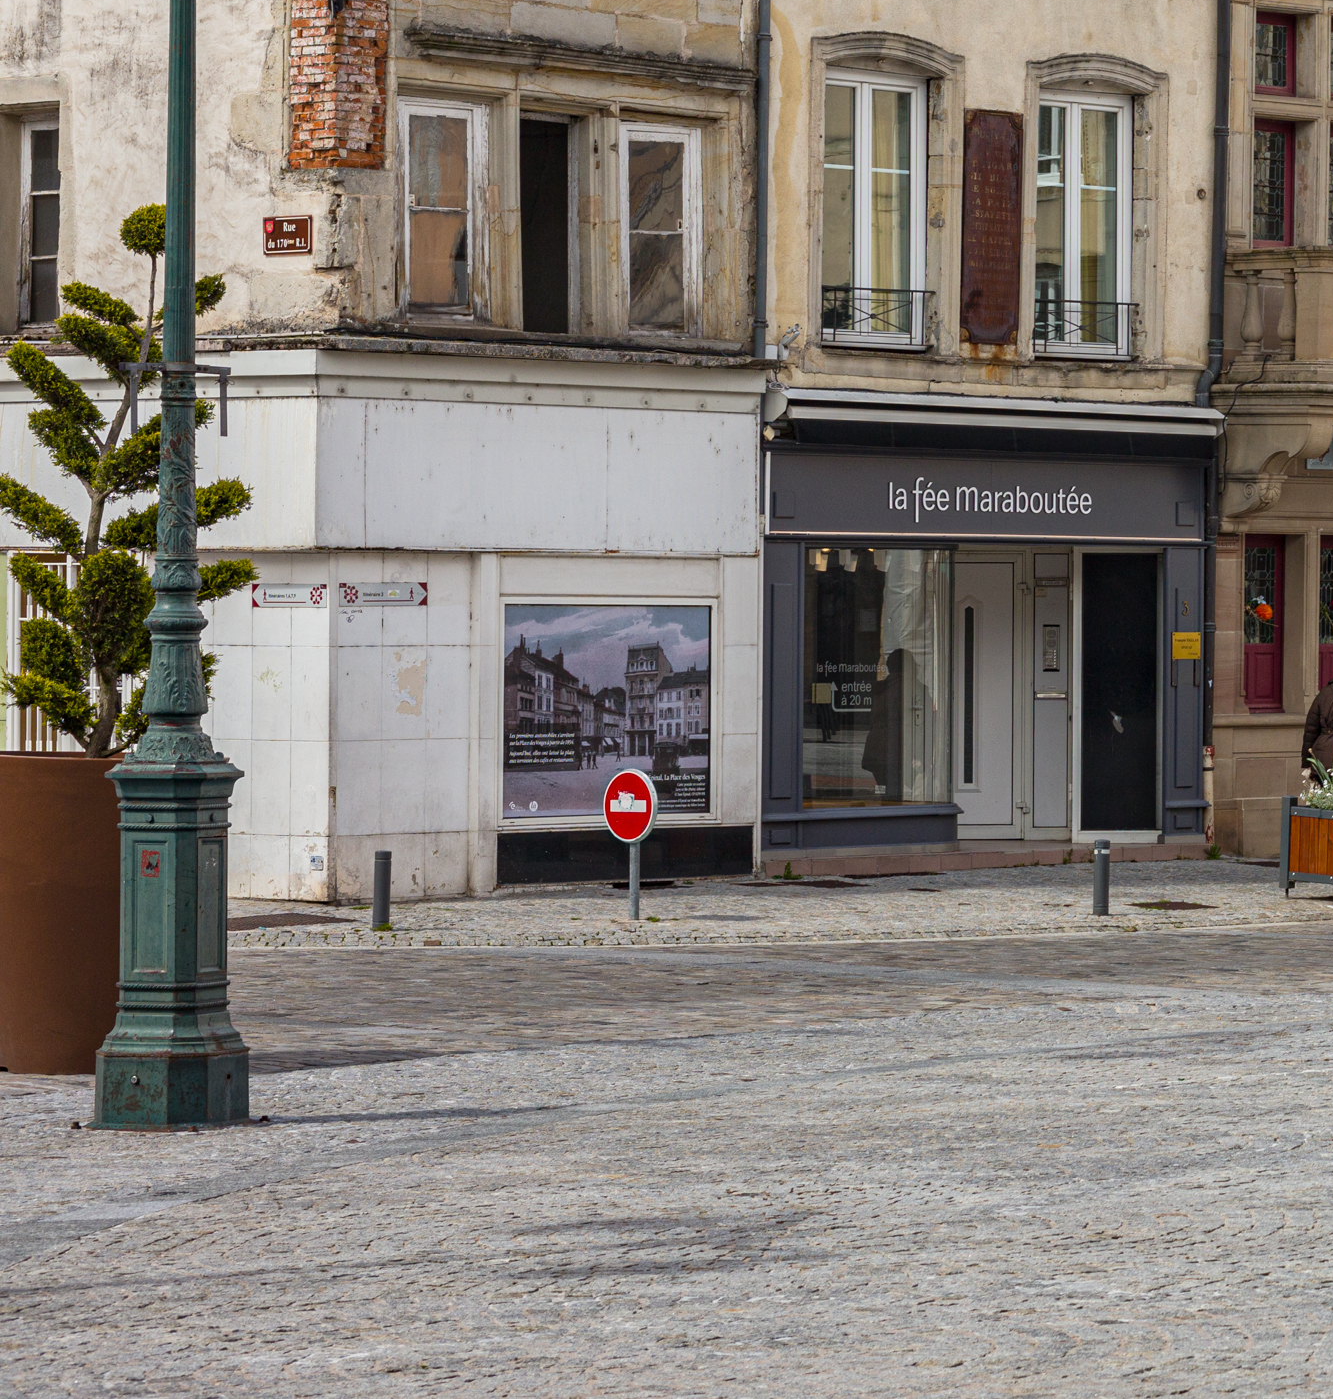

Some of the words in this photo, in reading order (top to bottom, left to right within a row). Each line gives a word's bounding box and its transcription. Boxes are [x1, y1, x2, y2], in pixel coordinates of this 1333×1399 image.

[283, 222, 296, 232] Rue
[267, 238, 275, 249] du
[888, 482, 908, 510] la
[912, 477, 950, 523] fée
[955, 485, 1093, 515] maraboutée
[817, 663, 823, 672] la
[825, 661, 837, 677] fée
[839, 663, 886, 673] maraboutée
[841, 681, 872, 692] entrée
[841, 695, 847, 705] à
[850, 695, 861, 705] 20
[864, 697, 872, 705] m
